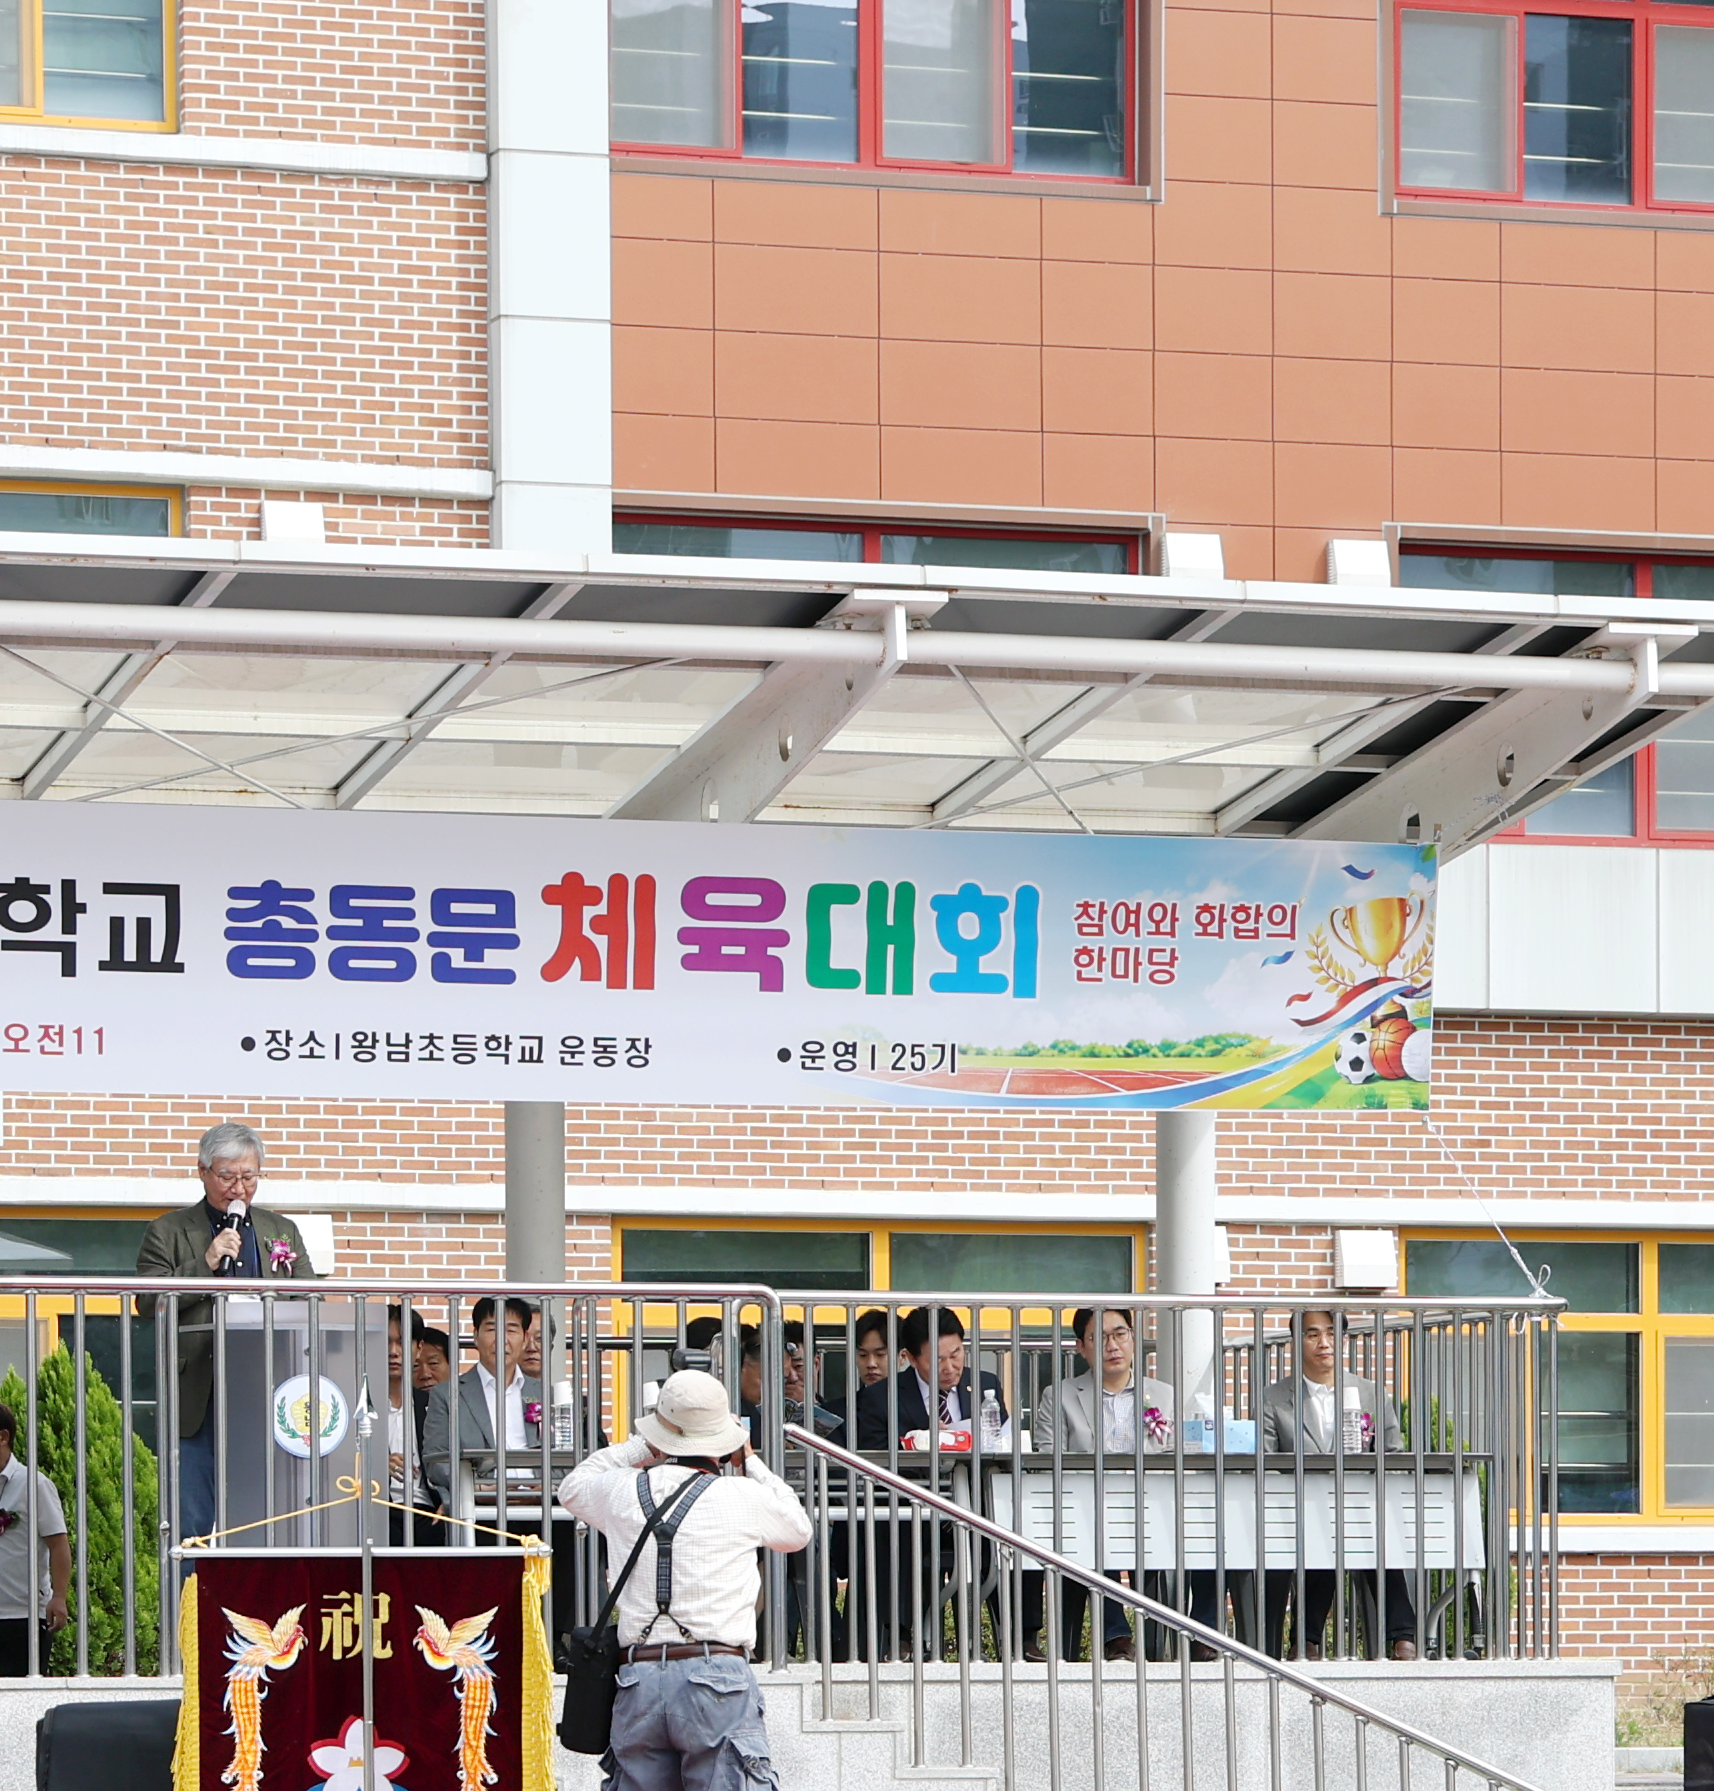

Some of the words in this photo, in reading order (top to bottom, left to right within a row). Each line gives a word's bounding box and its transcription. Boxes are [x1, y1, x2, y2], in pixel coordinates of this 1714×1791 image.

[1073, 899, 1181, 940] 참여와
[1193, 901, 1300, 943] 화합의
[1072, 945, 1179, 986] 한마당
[1, 1022, 107, 1057] 오전11
[350, 1030, 546, 1066] 왕남초등학교
[558, 1035, 653, 1071] 운동장
[890, 1042, 958, 1076] 25기
[319, 1590, 394, 1661] 祝
